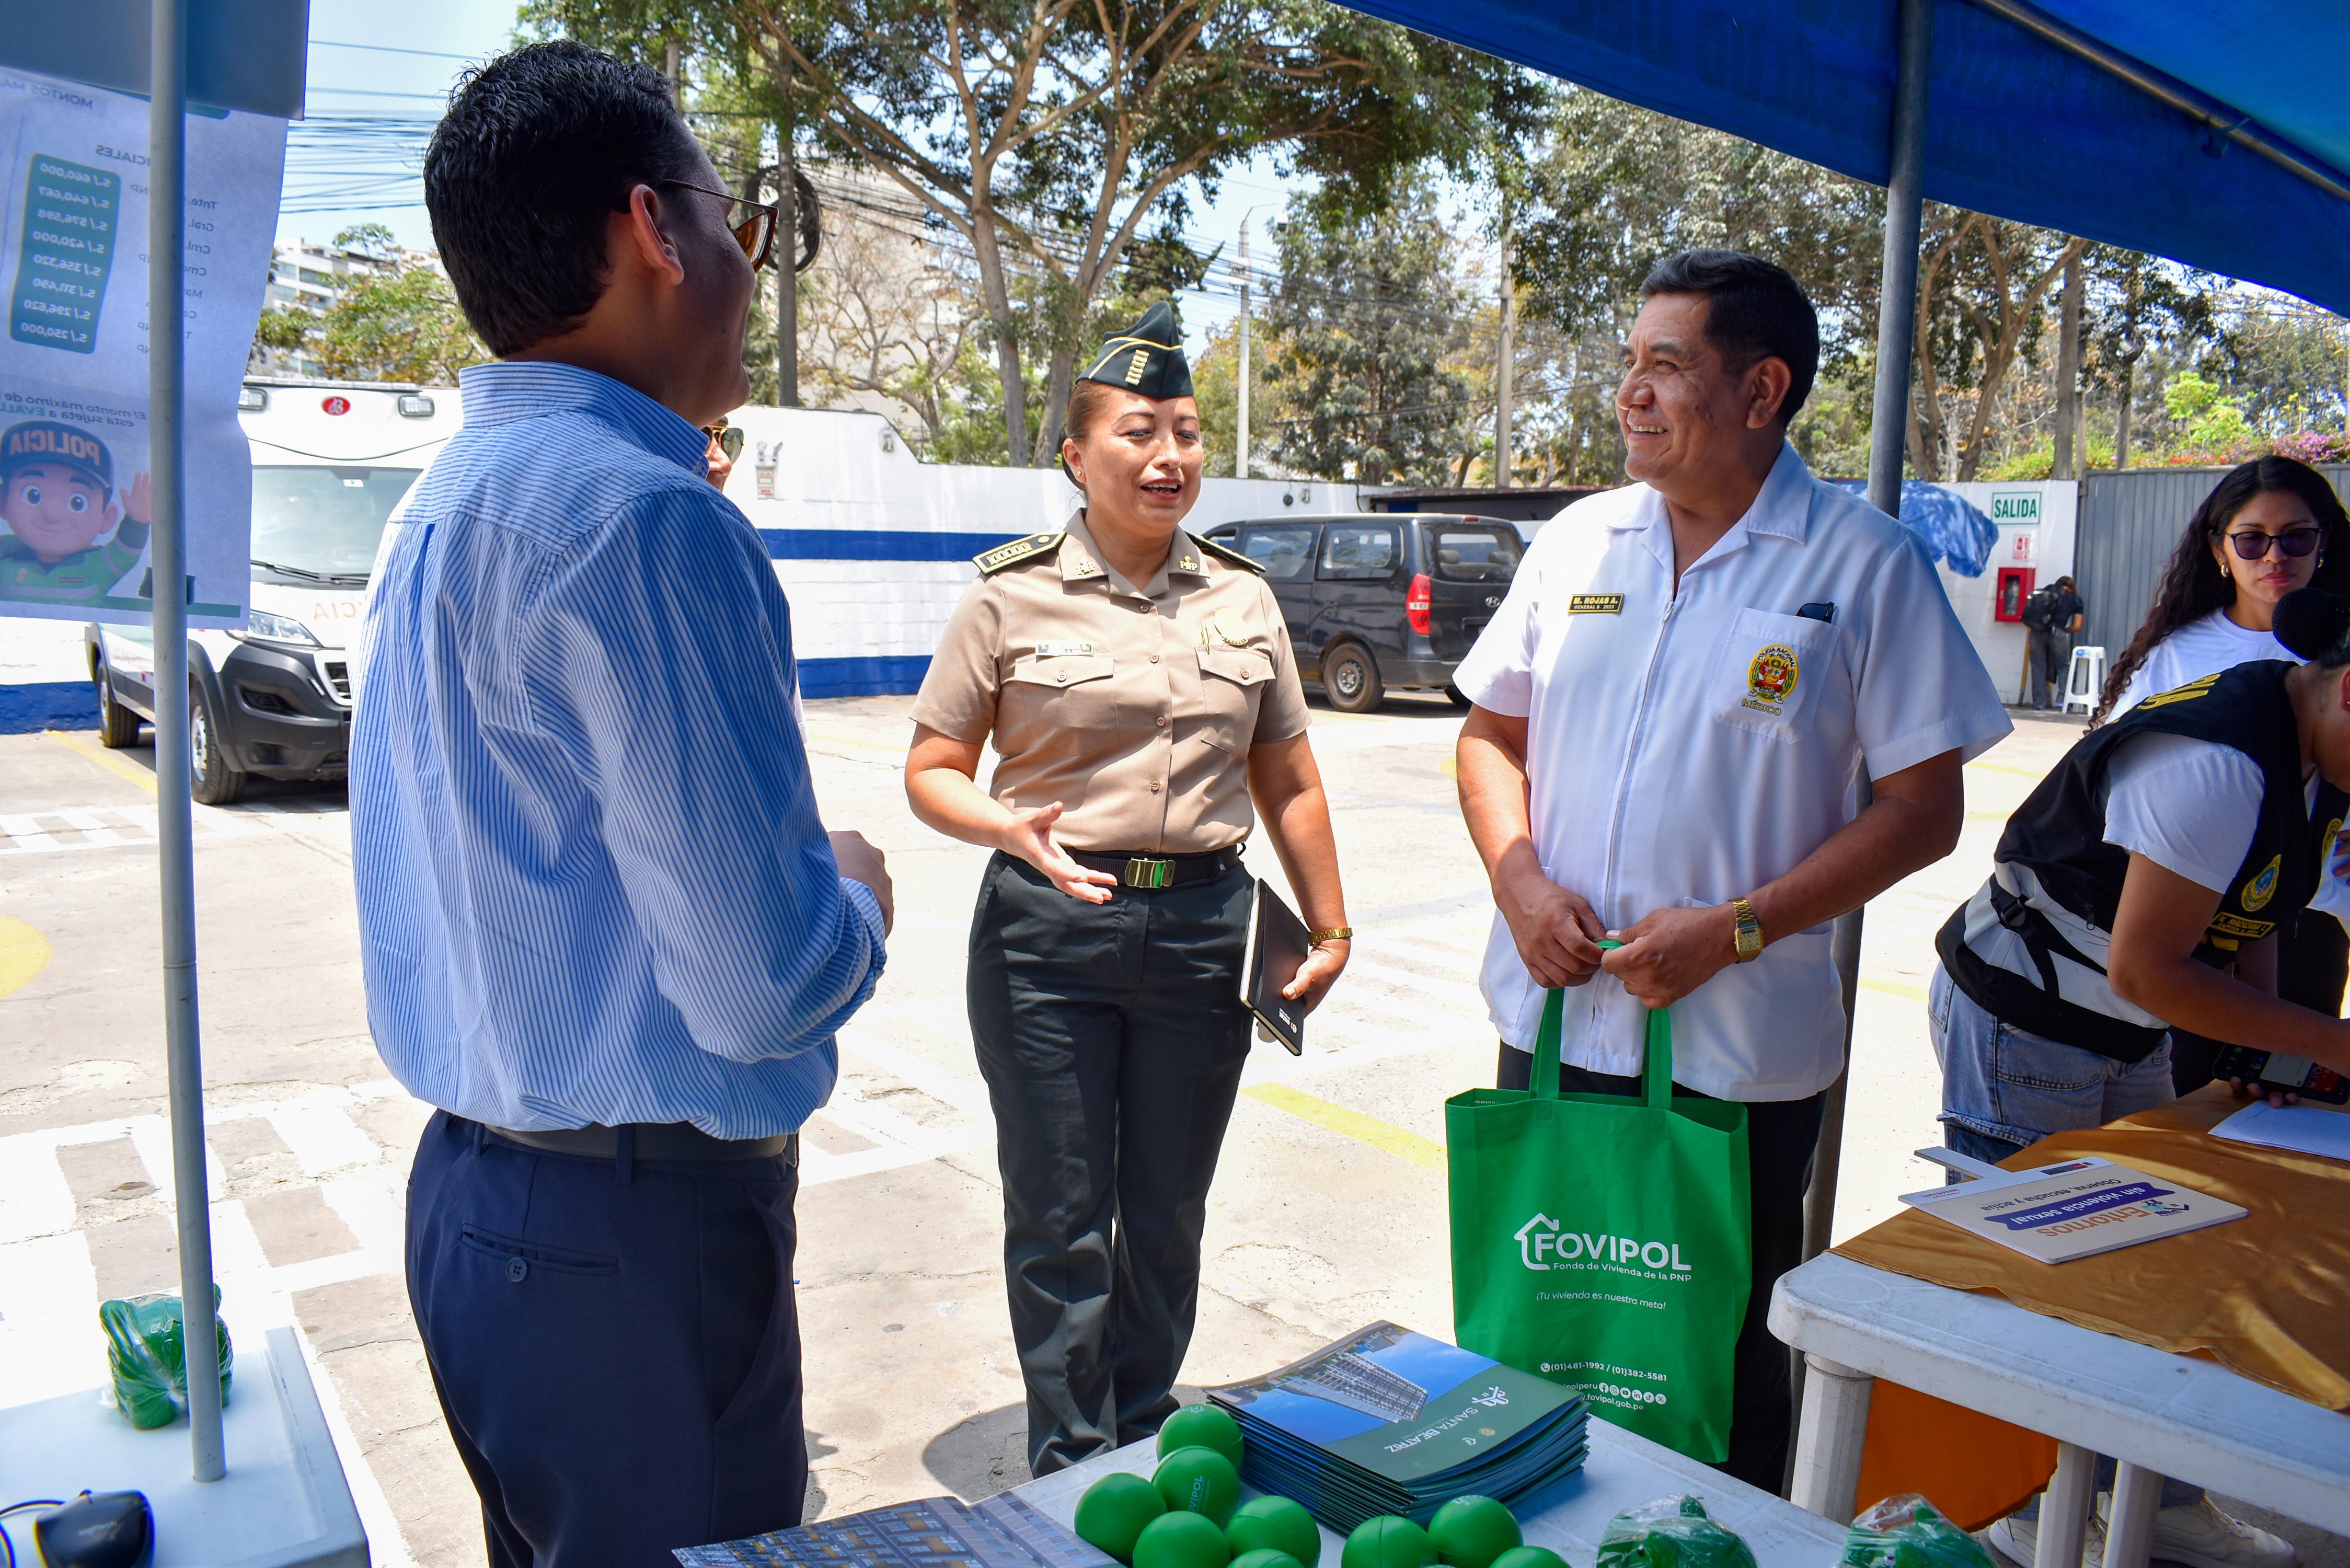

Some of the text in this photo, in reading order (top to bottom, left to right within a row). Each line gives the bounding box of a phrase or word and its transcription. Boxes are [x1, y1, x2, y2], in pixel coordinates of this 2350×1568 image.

[1995, 499, 2037, 518] SALIDA
[1741, 699, 1782, 716] MÉDICO
[2069, 1178, 2122, 1192] Observa,
[2023, 1188, 2071, 1203] escucha
[1980, 1200, 2015, 1211] actúa
[2010, 1186, 2146, 1225] sin violencia sexual
[2038, 1206, 2152, 1237] Entornos
[1535, 1232, 1692, 1271] FOVIPOL
[1553, 1262, 1584, 1270] Fondo
[1601, 1262, 1641, 1277] Vivienda
[1644, 1270, 1656, 1278] de
[1658, 1272, 1667, 1280] la
[1670, 1273, 1692, 1282] PNP
[1536, 1292, 1550, 1300] ¡Tu
[1552, 1291, 1590, 1299] vivienda
[1605, 1293, 1638, 1305] nuestra
[1640, 1300, 1666, 1310] meta!
[1551, 1362, 1605, 1372] (01)481-1992
[1612, 1366, 1667, 1381] (01)382-5581
[1384, 1407, 1478, 1452] SANTA BEATRIZ
[1188, 1475, 1202, 1513] OVIPOL
